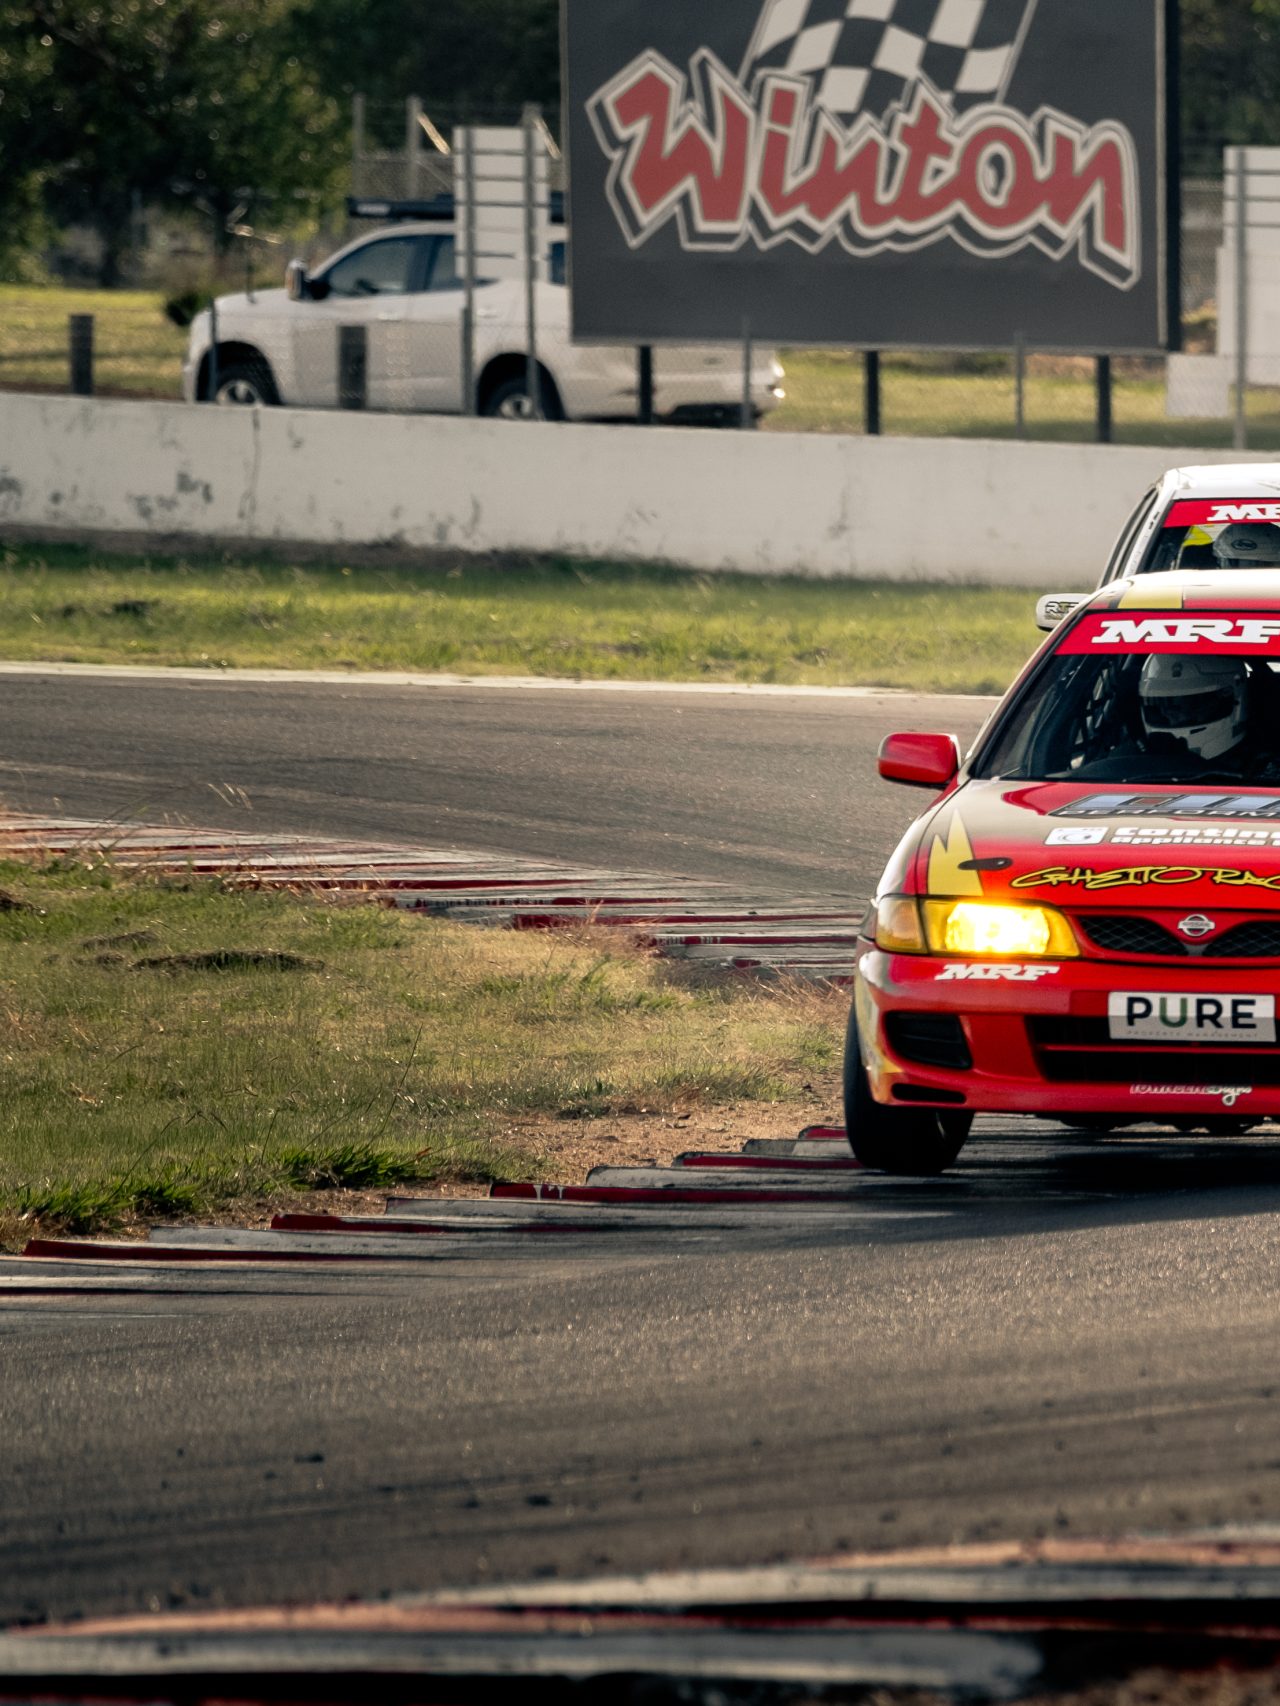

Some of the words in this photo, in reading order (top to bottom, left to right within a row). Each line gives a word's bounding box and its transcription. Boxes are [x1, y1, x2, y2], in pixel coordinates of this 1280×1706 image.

[586, 48, 1142, 290] Winton
[1110, 836, 1266, 846] Appliance
[935, 964, 1059, 981] MRF
[1126, 996, 1257, 1029] PURE
